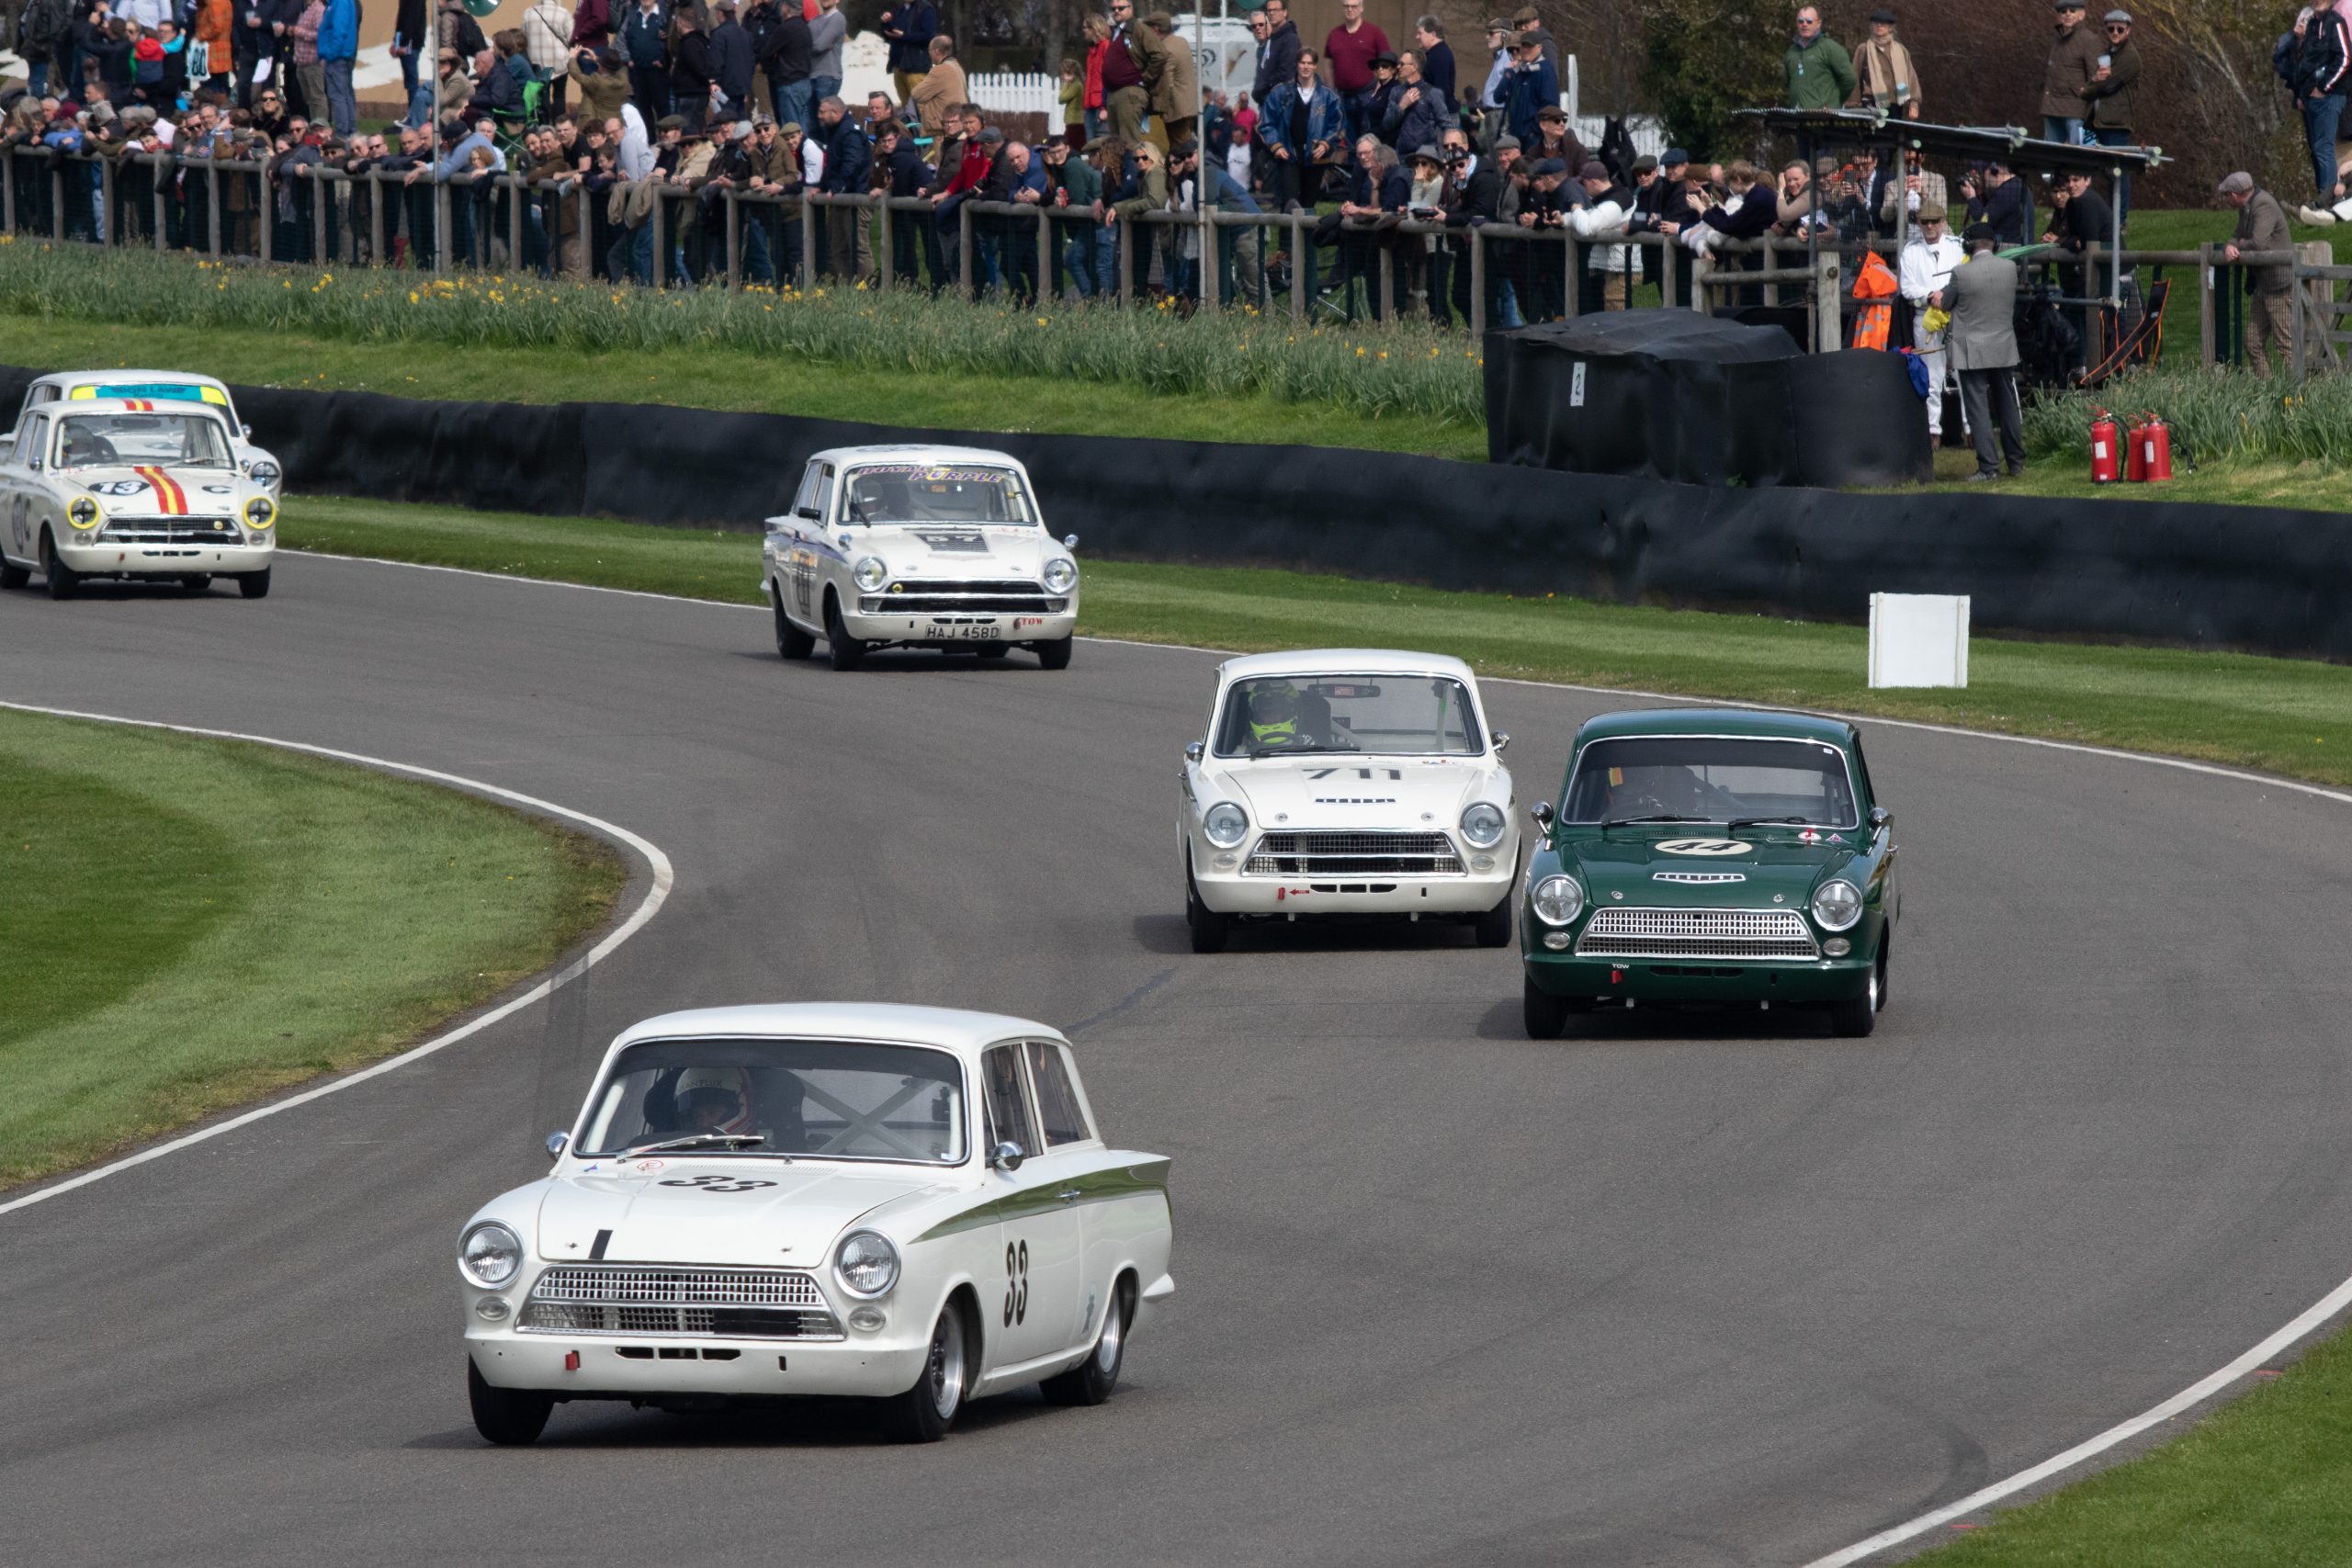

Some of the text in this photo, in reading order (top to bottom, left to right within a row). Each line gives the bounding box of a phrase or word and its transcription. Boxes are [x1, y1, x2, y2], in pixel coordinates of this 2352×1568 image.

[908, 467, 1003, 483] PURPLE
[927, 627, 999, 638] HAJ 458D
[1664, 841, 1740, 852] 44
[658, 1176, 778, 1192] 33
[1004, 1239, 1028, 1328] 33
